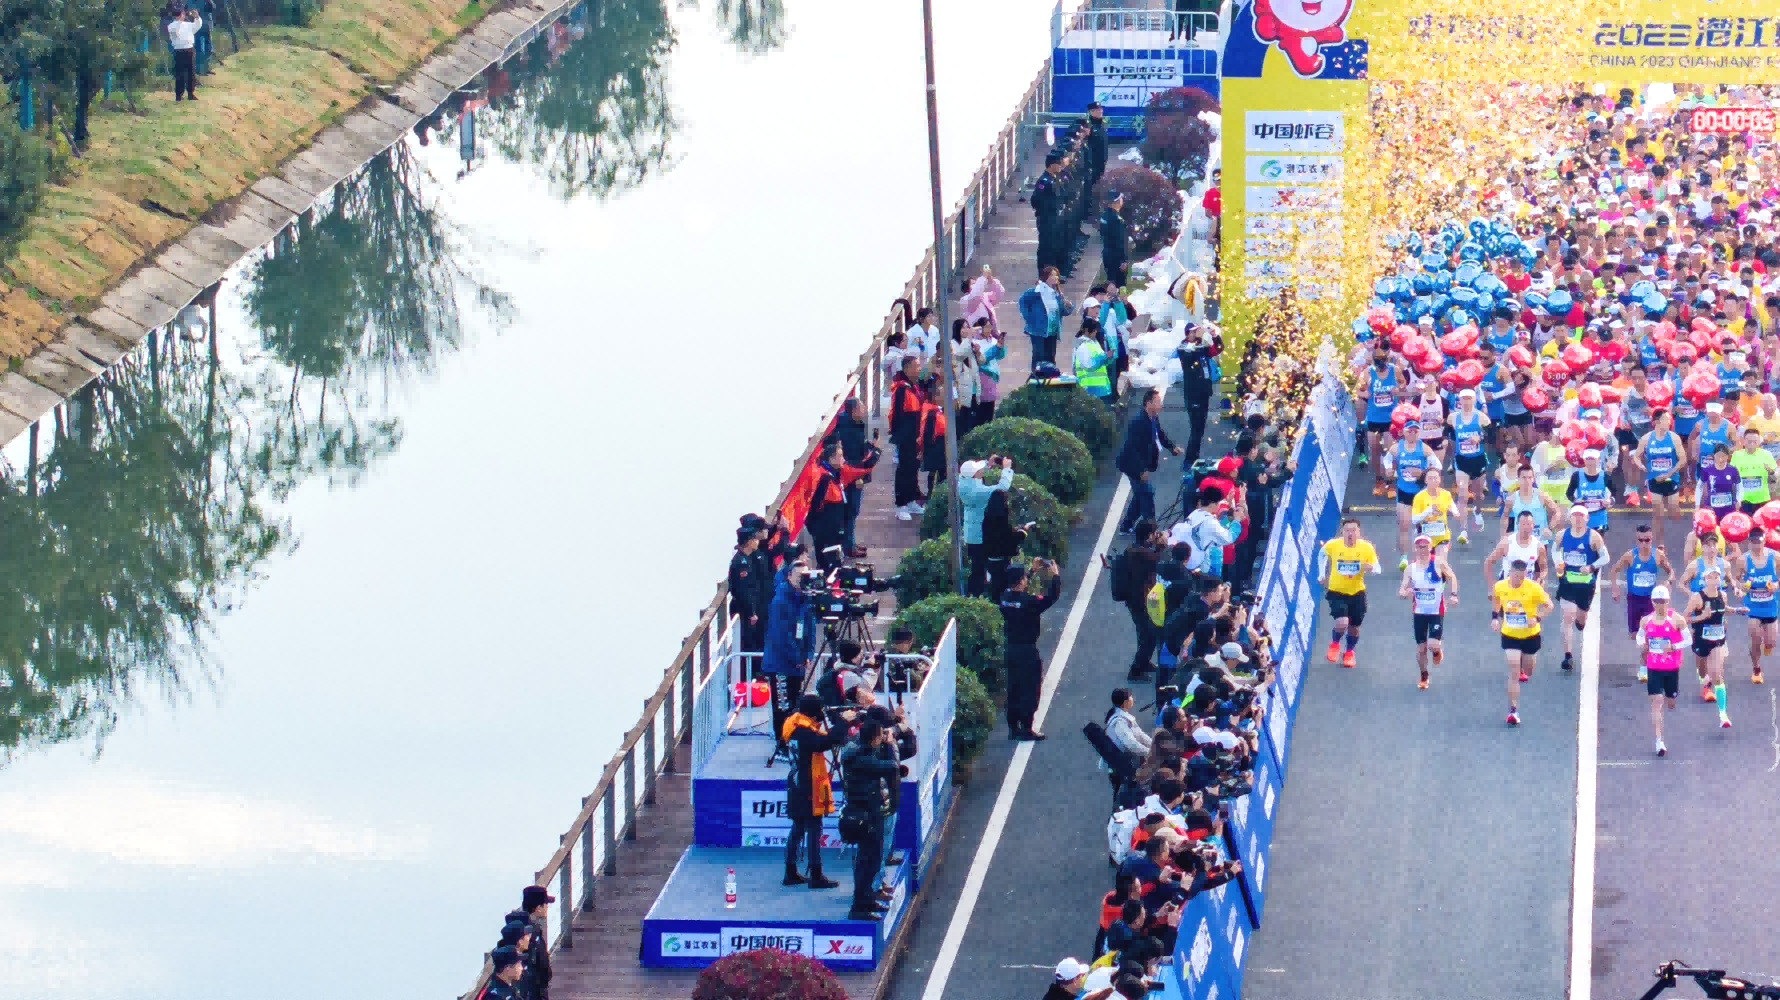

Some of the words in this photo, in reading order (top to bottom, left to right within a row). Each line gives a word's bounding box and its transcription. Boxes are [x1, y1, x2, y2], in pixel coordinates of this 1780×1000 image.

[1590, 55, 1636, 68] CHINA
[1640, 55, 1674, 68] 2023
[1679, 55, 1761, 69] QIANJIANG
[1253, 123, 1335, 140] 中国虾谷
[684, 940, 718, 950] 潜江农发
[730, 935, 803, 952] 中国虾谷
